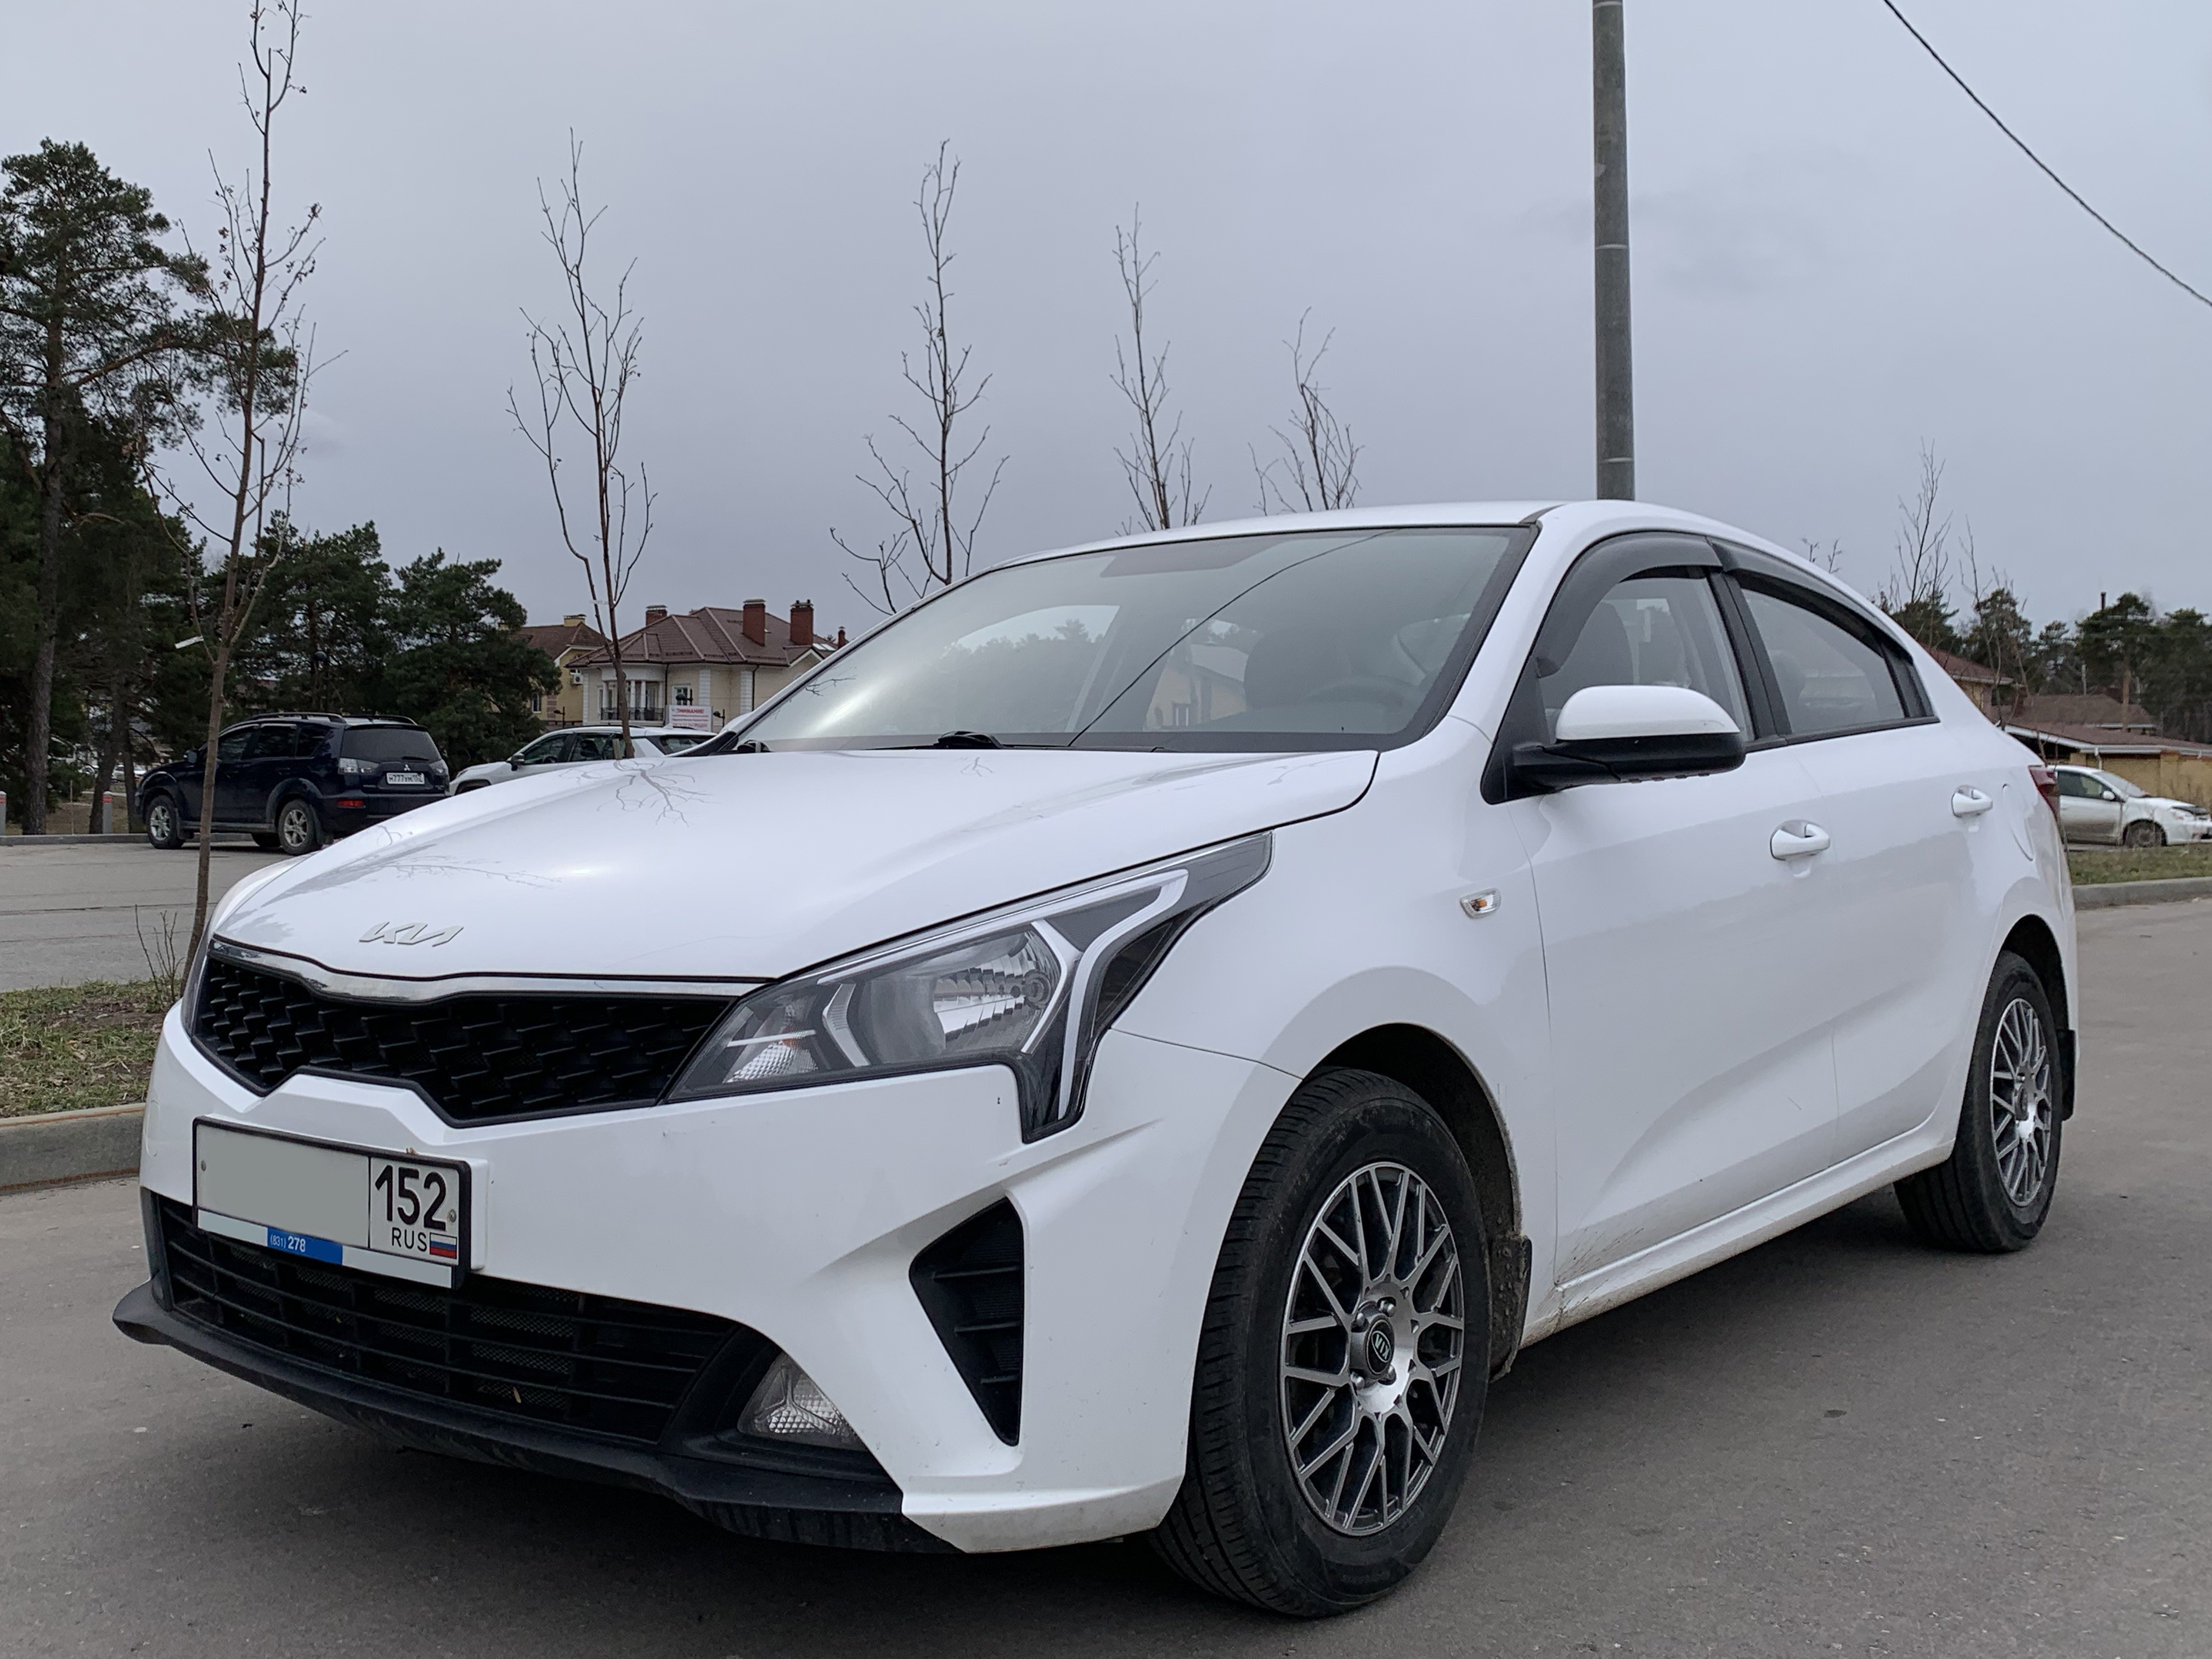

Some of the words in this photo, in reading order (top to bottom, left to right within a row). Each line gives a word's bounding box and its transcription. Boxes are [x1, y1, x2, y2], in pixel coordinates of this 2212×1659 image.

[358, 922, 464, 947] KIA
[375, 1164, 447, 1231] 152
[270, 1234, 286, 1249] (831)
[288, 1235, 306, 1252] 278
[392, 1227, 427, 1252] RUS
[1375, 1334, 1390, 1360] KIA
